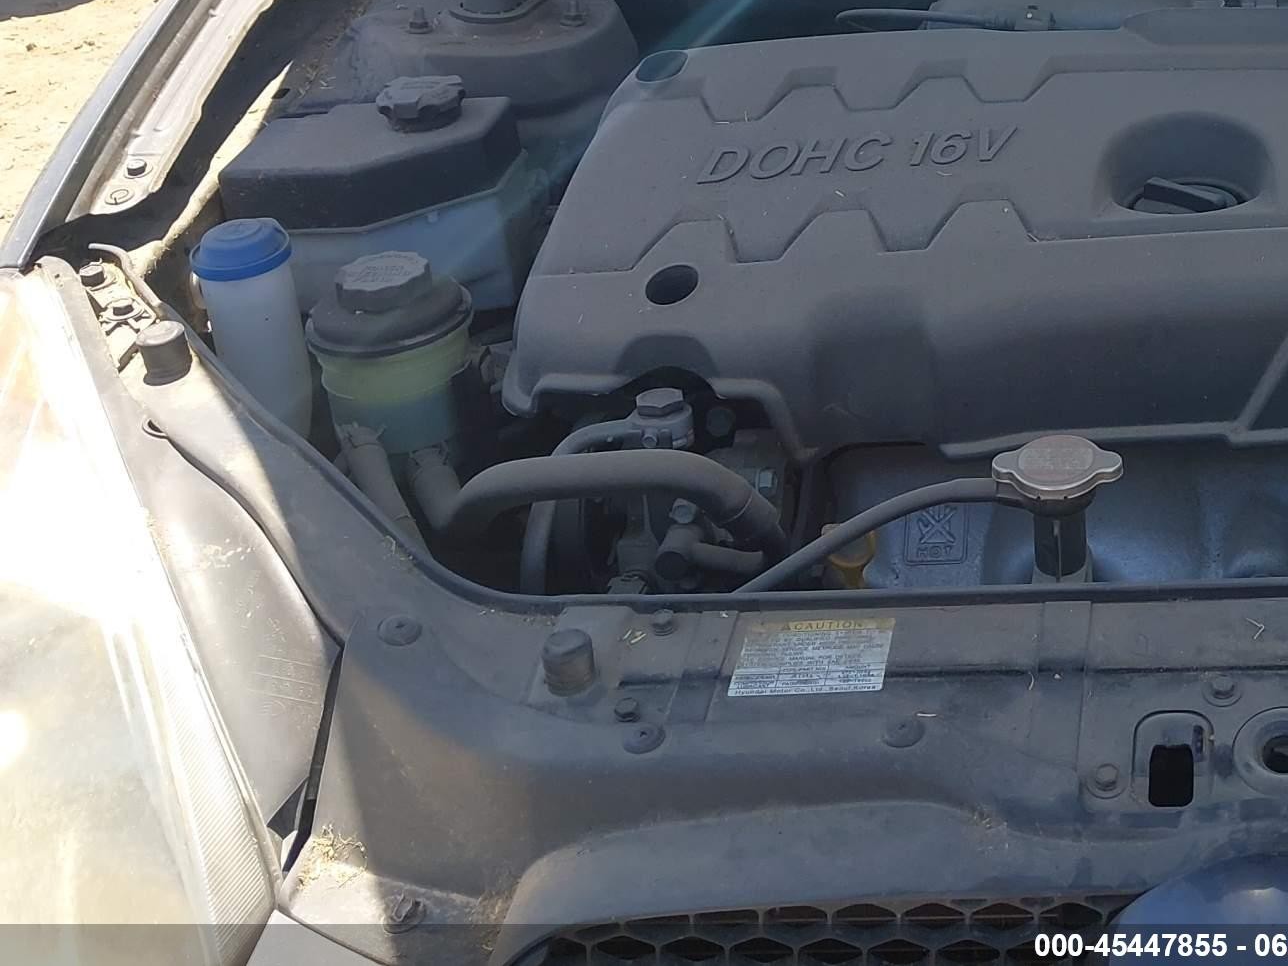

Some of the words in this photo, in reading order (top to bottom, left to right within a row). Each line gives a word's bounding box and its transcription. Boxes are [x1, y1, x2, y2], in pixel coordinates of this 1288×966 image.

[697, 133, 894, 185] DOHC
[909, 126, 1019, 166] 16V
[917, 545, 954, 558] HOT
[793, 620, 864, 630] CAUTION
